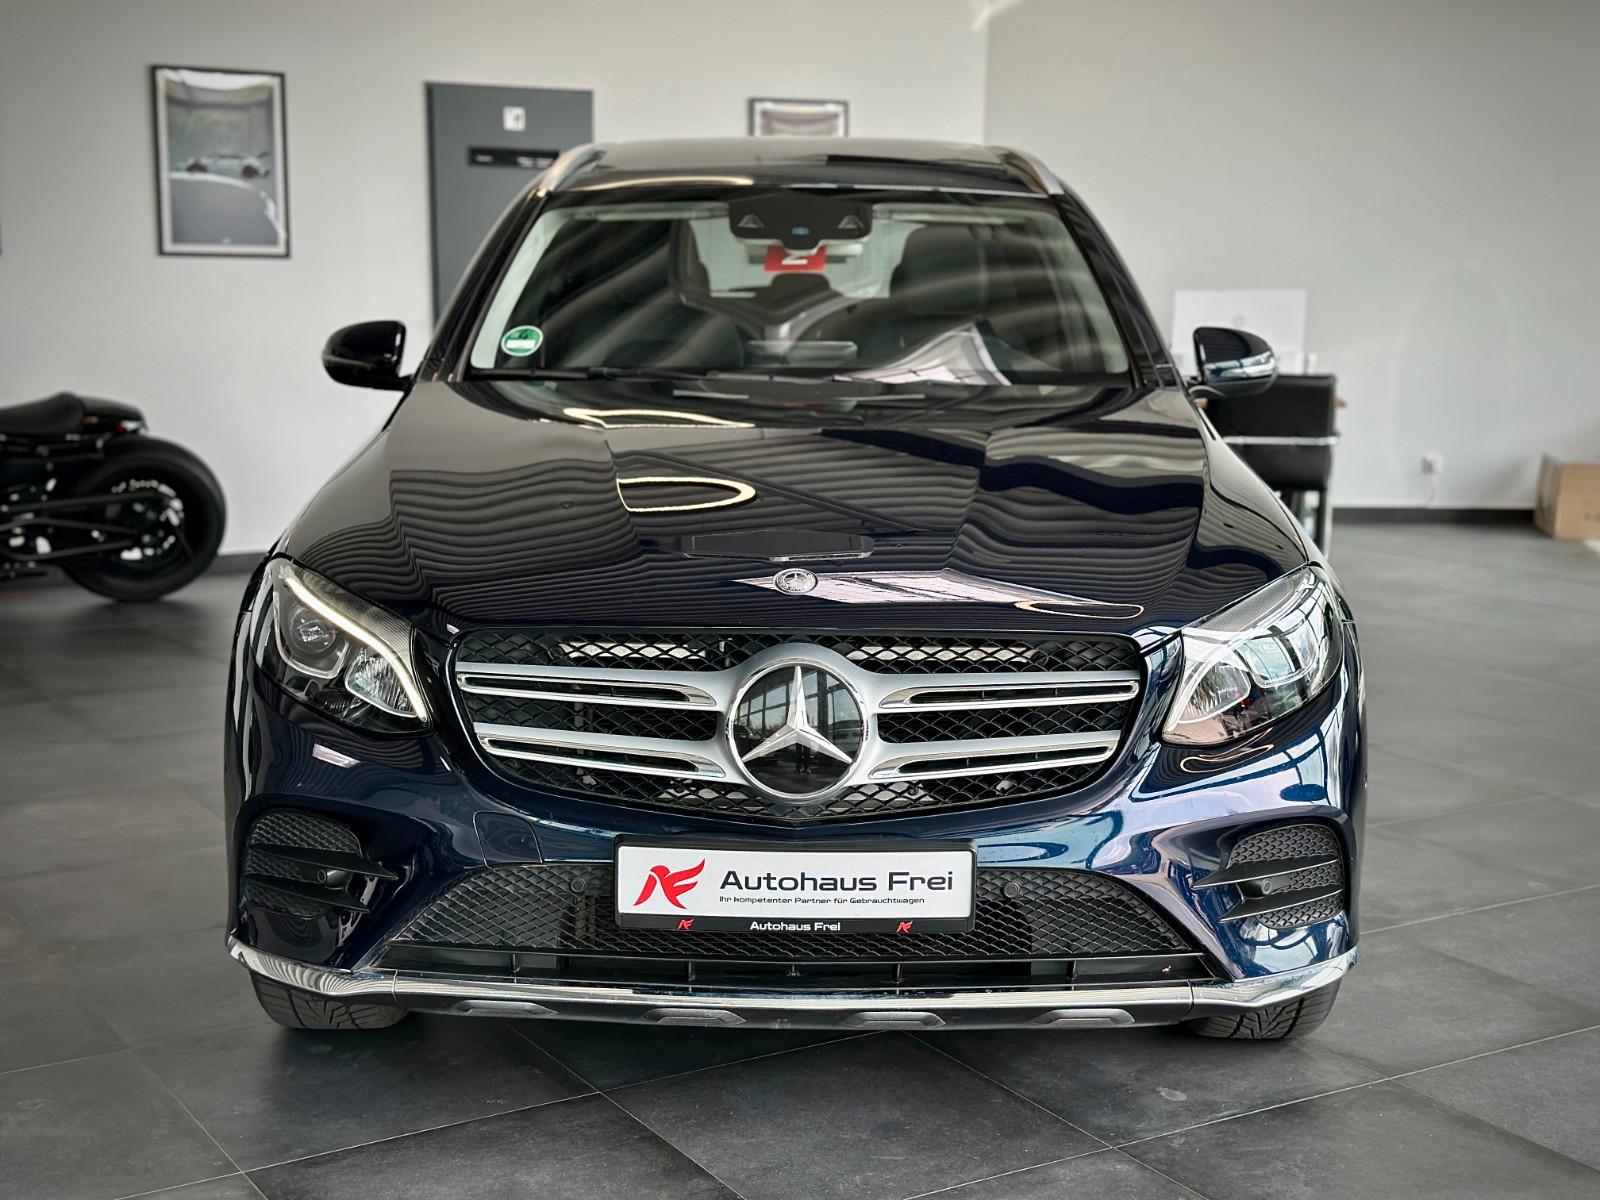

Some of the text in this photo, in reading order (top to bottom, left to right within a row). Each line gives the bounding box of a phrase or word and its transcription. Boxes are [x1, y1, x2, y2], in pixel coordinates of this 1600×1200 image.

[720, 870, 953, 891] Autohaus Frei
[733, 896, 792, 904] kompetenter
[850, 897, 925, 905] Gebrauchtwagen
[750, 921, 841, 931] Autohaus Frei
